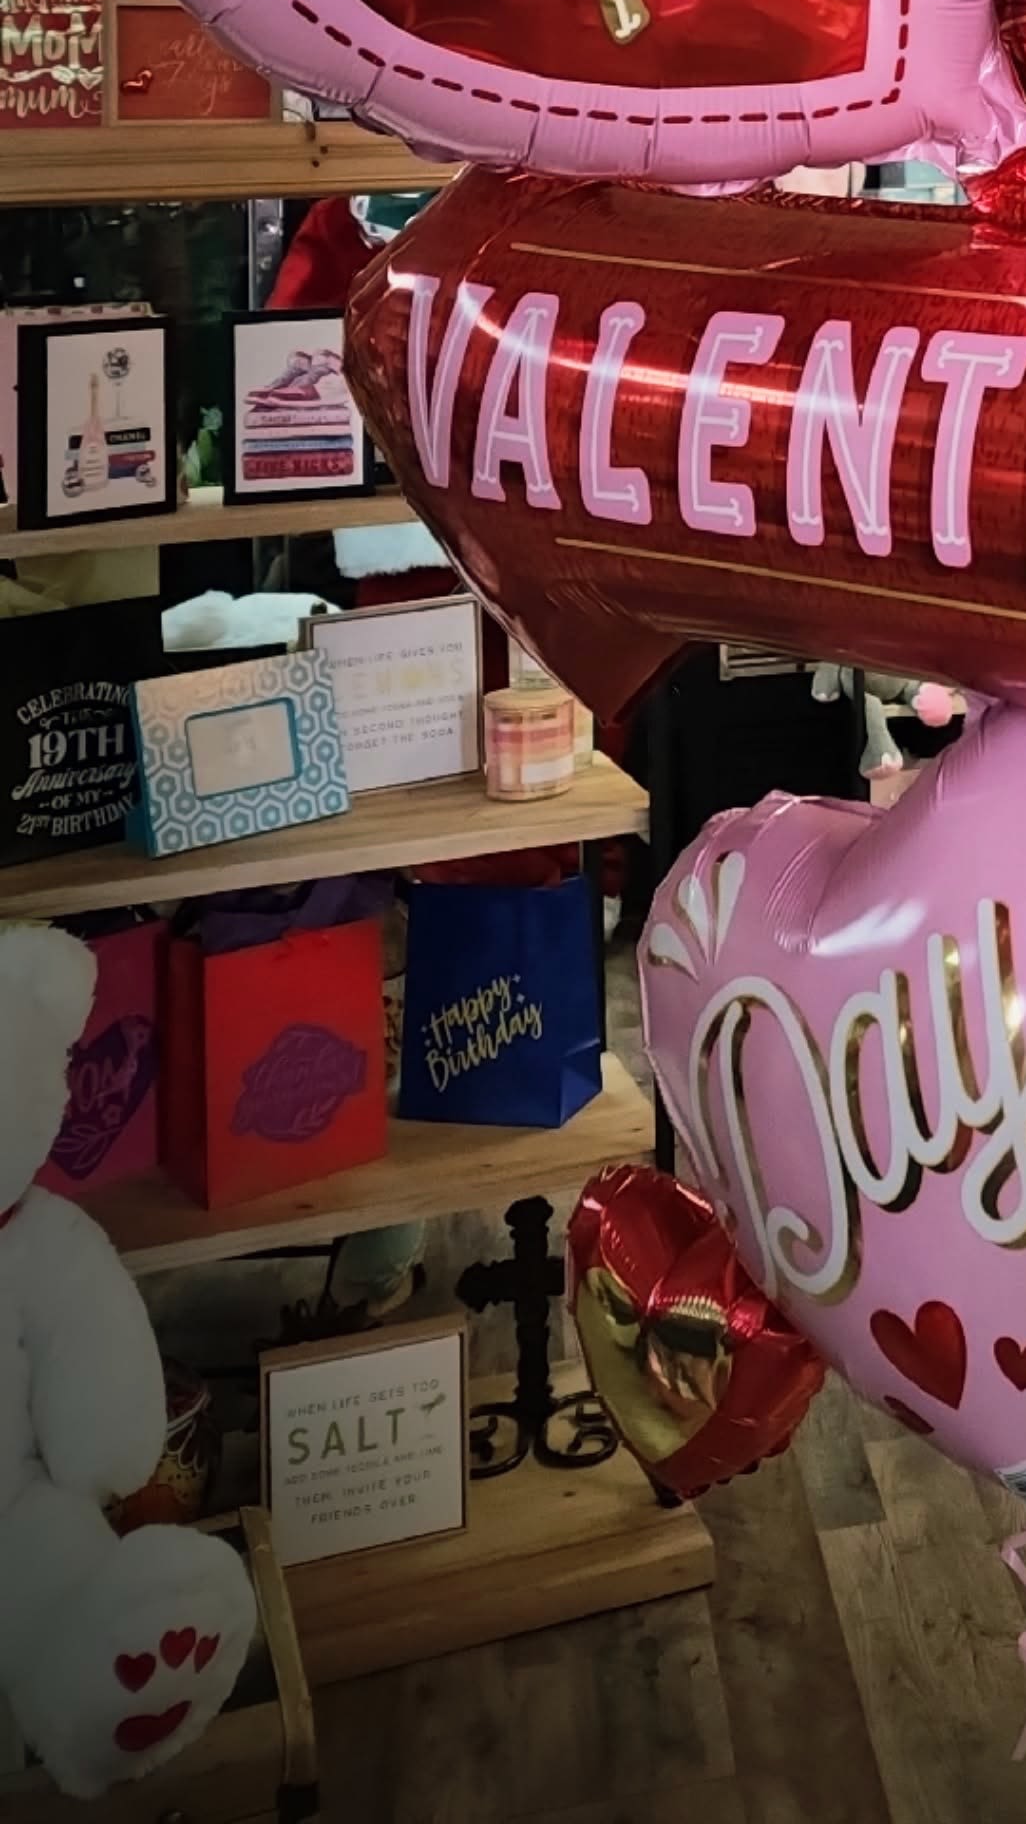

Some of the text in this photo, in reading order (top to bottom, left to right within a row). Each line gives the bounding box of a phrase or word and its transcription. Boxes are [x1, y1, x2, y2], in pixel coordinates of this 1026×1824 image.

[400, 645, 435, 658] GIVES
[353, 719, 403, 736] SECOND
[409, 709, 465, 726] THOUGHT
[393, 733, 414, 745] THE
[421, 726, 455, 740] SODA
[28, 723, 124, 769] 19TH
[11, 761, 137, 801] Anniversary
[78, 789, 101, 805] MY
[51, 792, 136, 836] BIRTHDAY
[430, 975, 511, 1050] Happy
[424, 1002, 543, 1093] Birthday
[287, 1378, 440, 1419] WHEN LIFE GETS TOO
[342, 1479, 388, 1497] INVITE
[395, 1469, 432, 1486] YOUR
[310, 1492, 417, 1525] FRIENDS OVER
